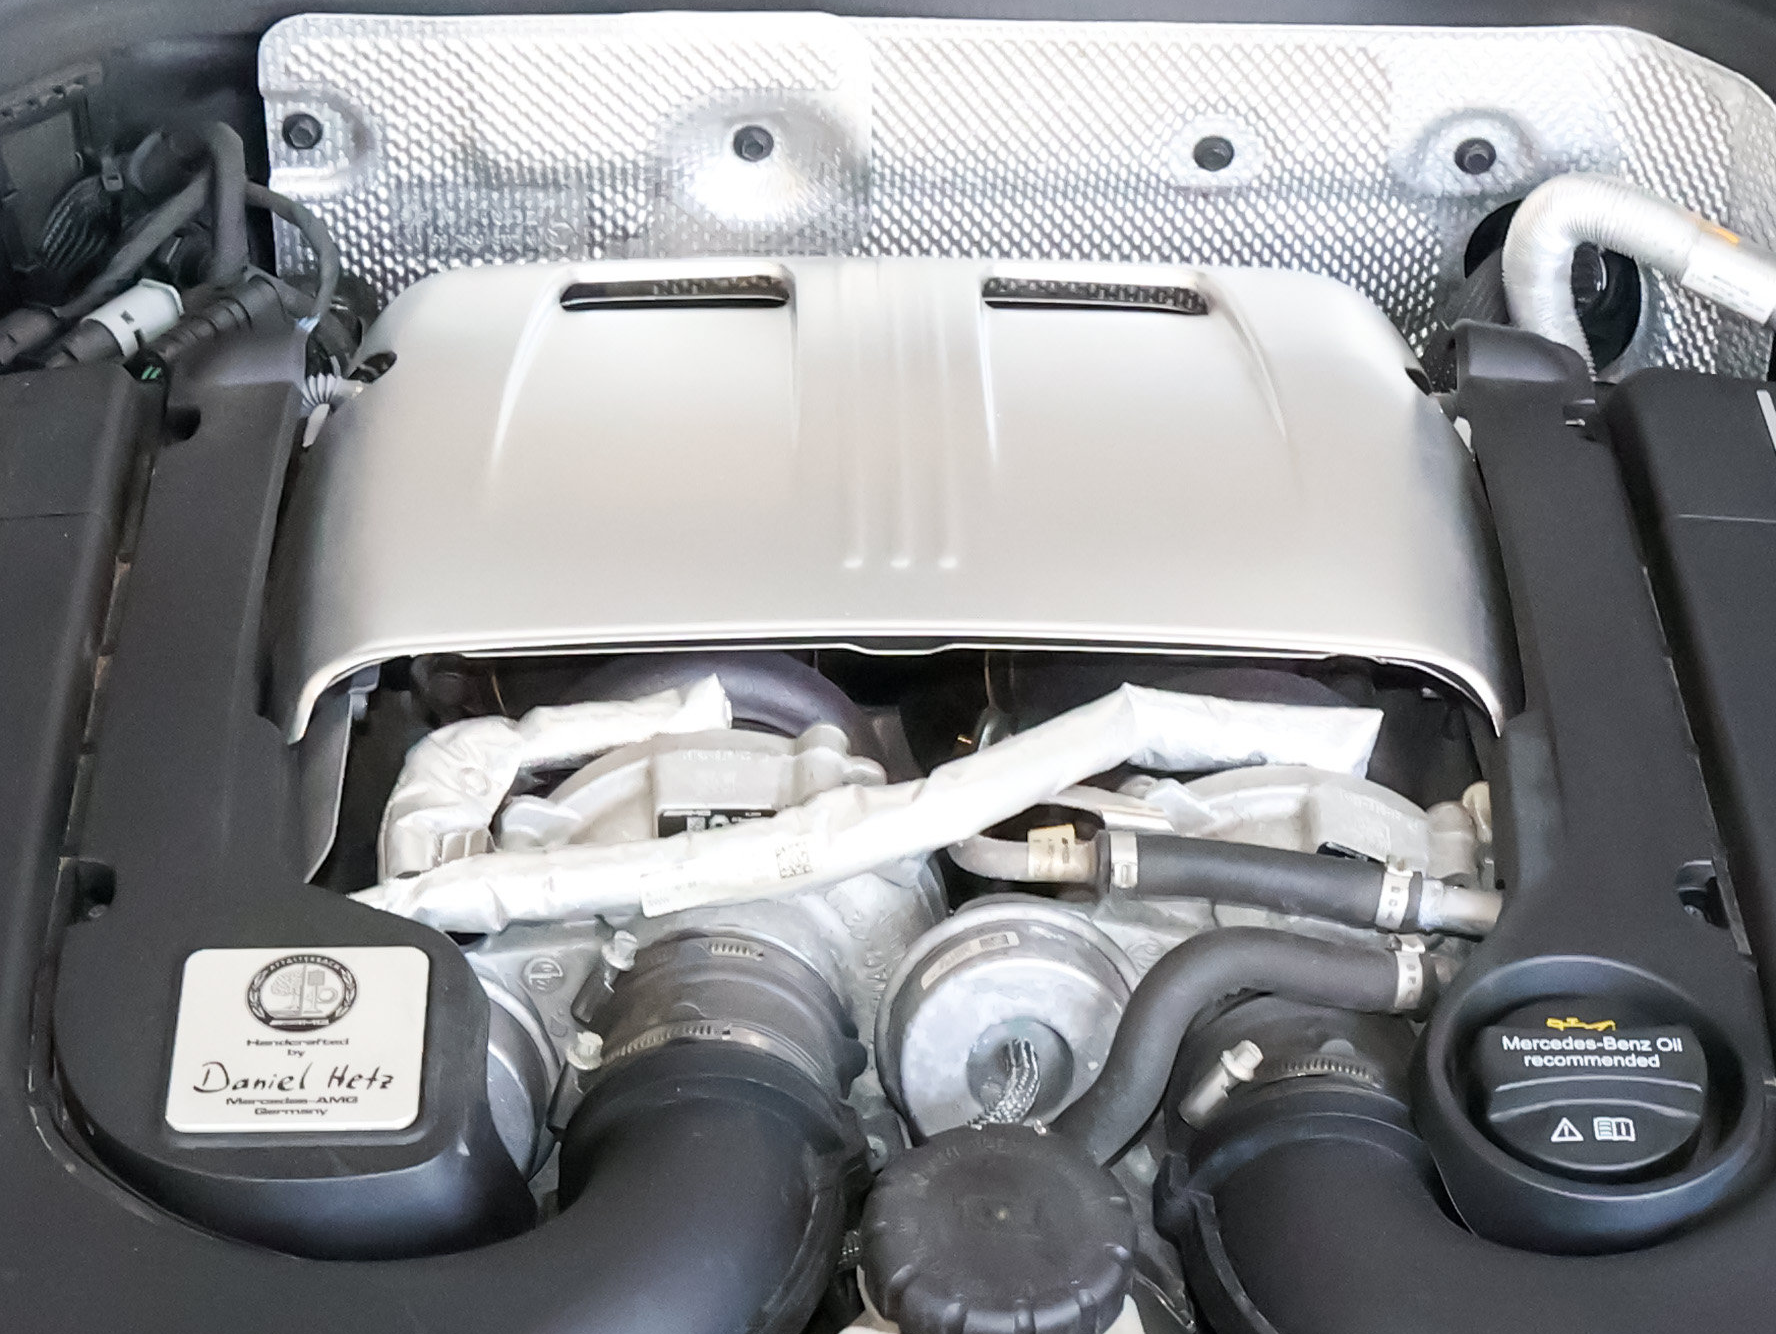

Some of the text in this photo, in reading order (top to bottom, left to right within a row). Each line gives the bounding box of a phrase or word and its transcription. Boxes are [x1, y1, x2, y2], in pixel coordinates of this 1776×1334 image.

[246, 1038, 349, 1046] Handcrafted
[1501, 1035, 1683, 1052] Mercedes-Benz Oil
[287, 1049, 305, 1058] by
[1524, 1053, 1660, 1068] recommended
[193, 1061, 313, 1093] Daniel
[226, 1096, 358, 1106] Mercedes-AMG
[254, 1107, 328, 1116] Germany
